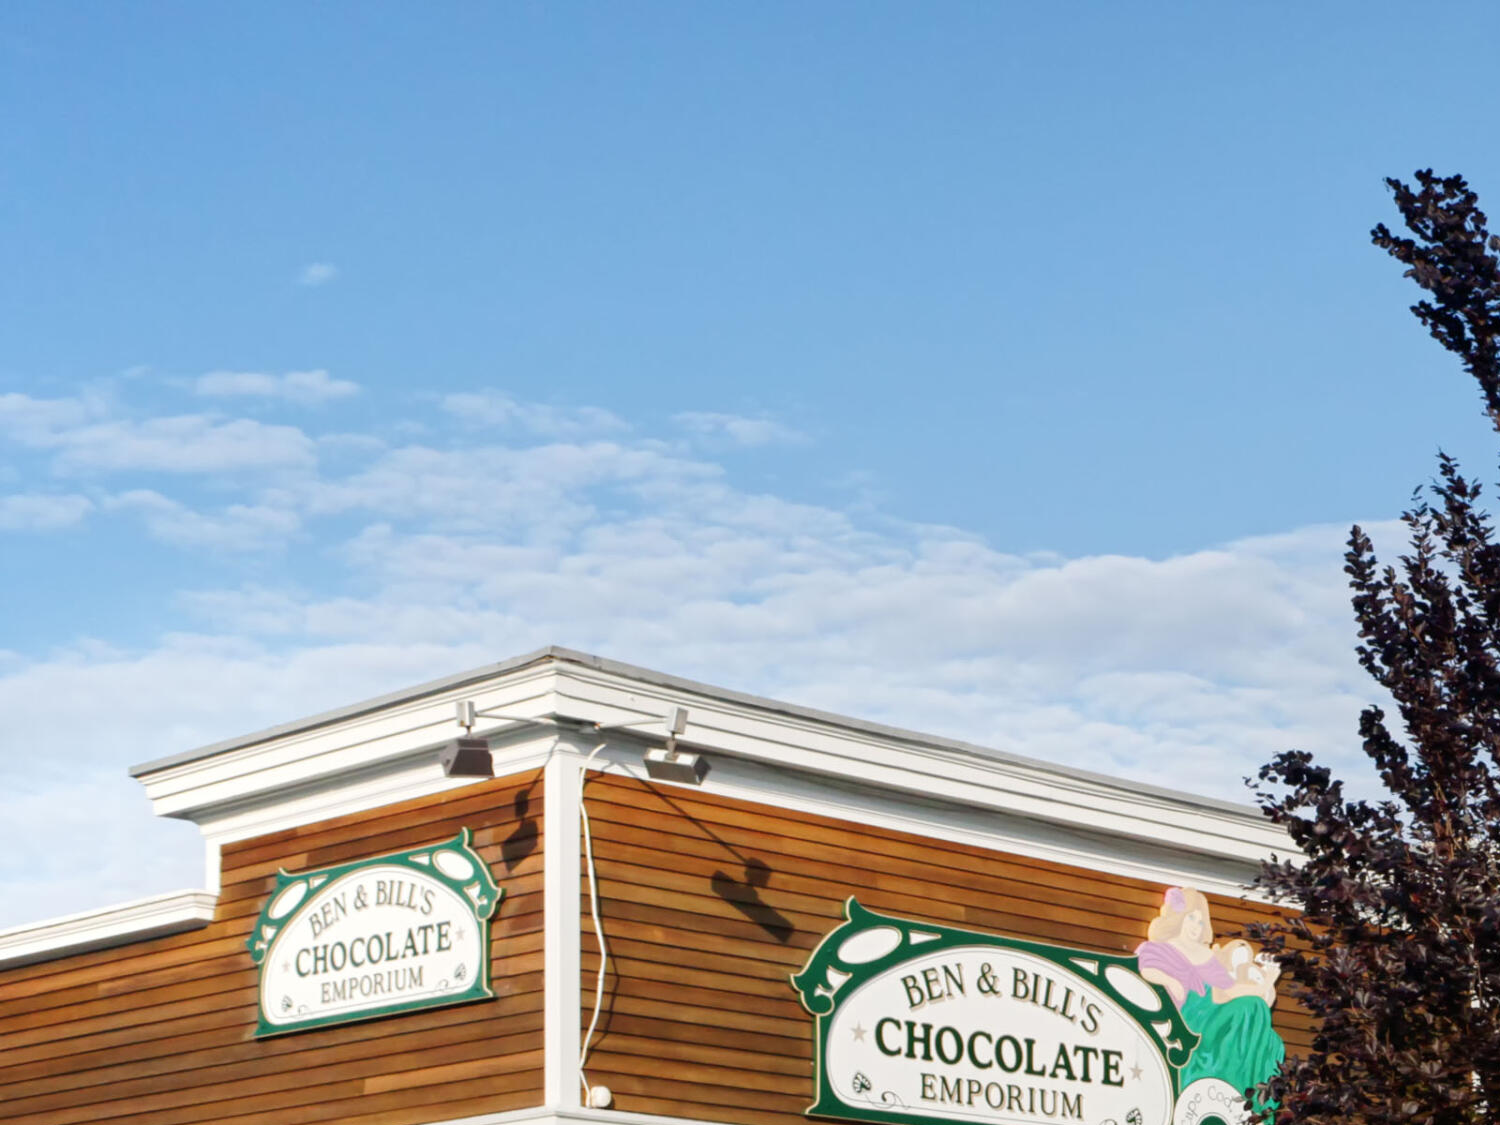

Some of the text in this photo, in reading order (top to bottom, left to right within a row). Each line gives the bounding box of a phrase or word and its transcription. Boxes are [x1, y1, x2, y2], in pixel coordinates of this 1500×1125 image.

[307, 880, 435, 939] BEN & BILL'S
[295, 921, 453, 978] CHOCOLATE
[321, 966, 425, 1005] EMPORIUM
[900, 962, 1104, 1036] BEN & BILL'S
[874, 1017, 1125, 1087] CHOCOLATE
[920, 1072, 1085, 1120] EMPORIUM
